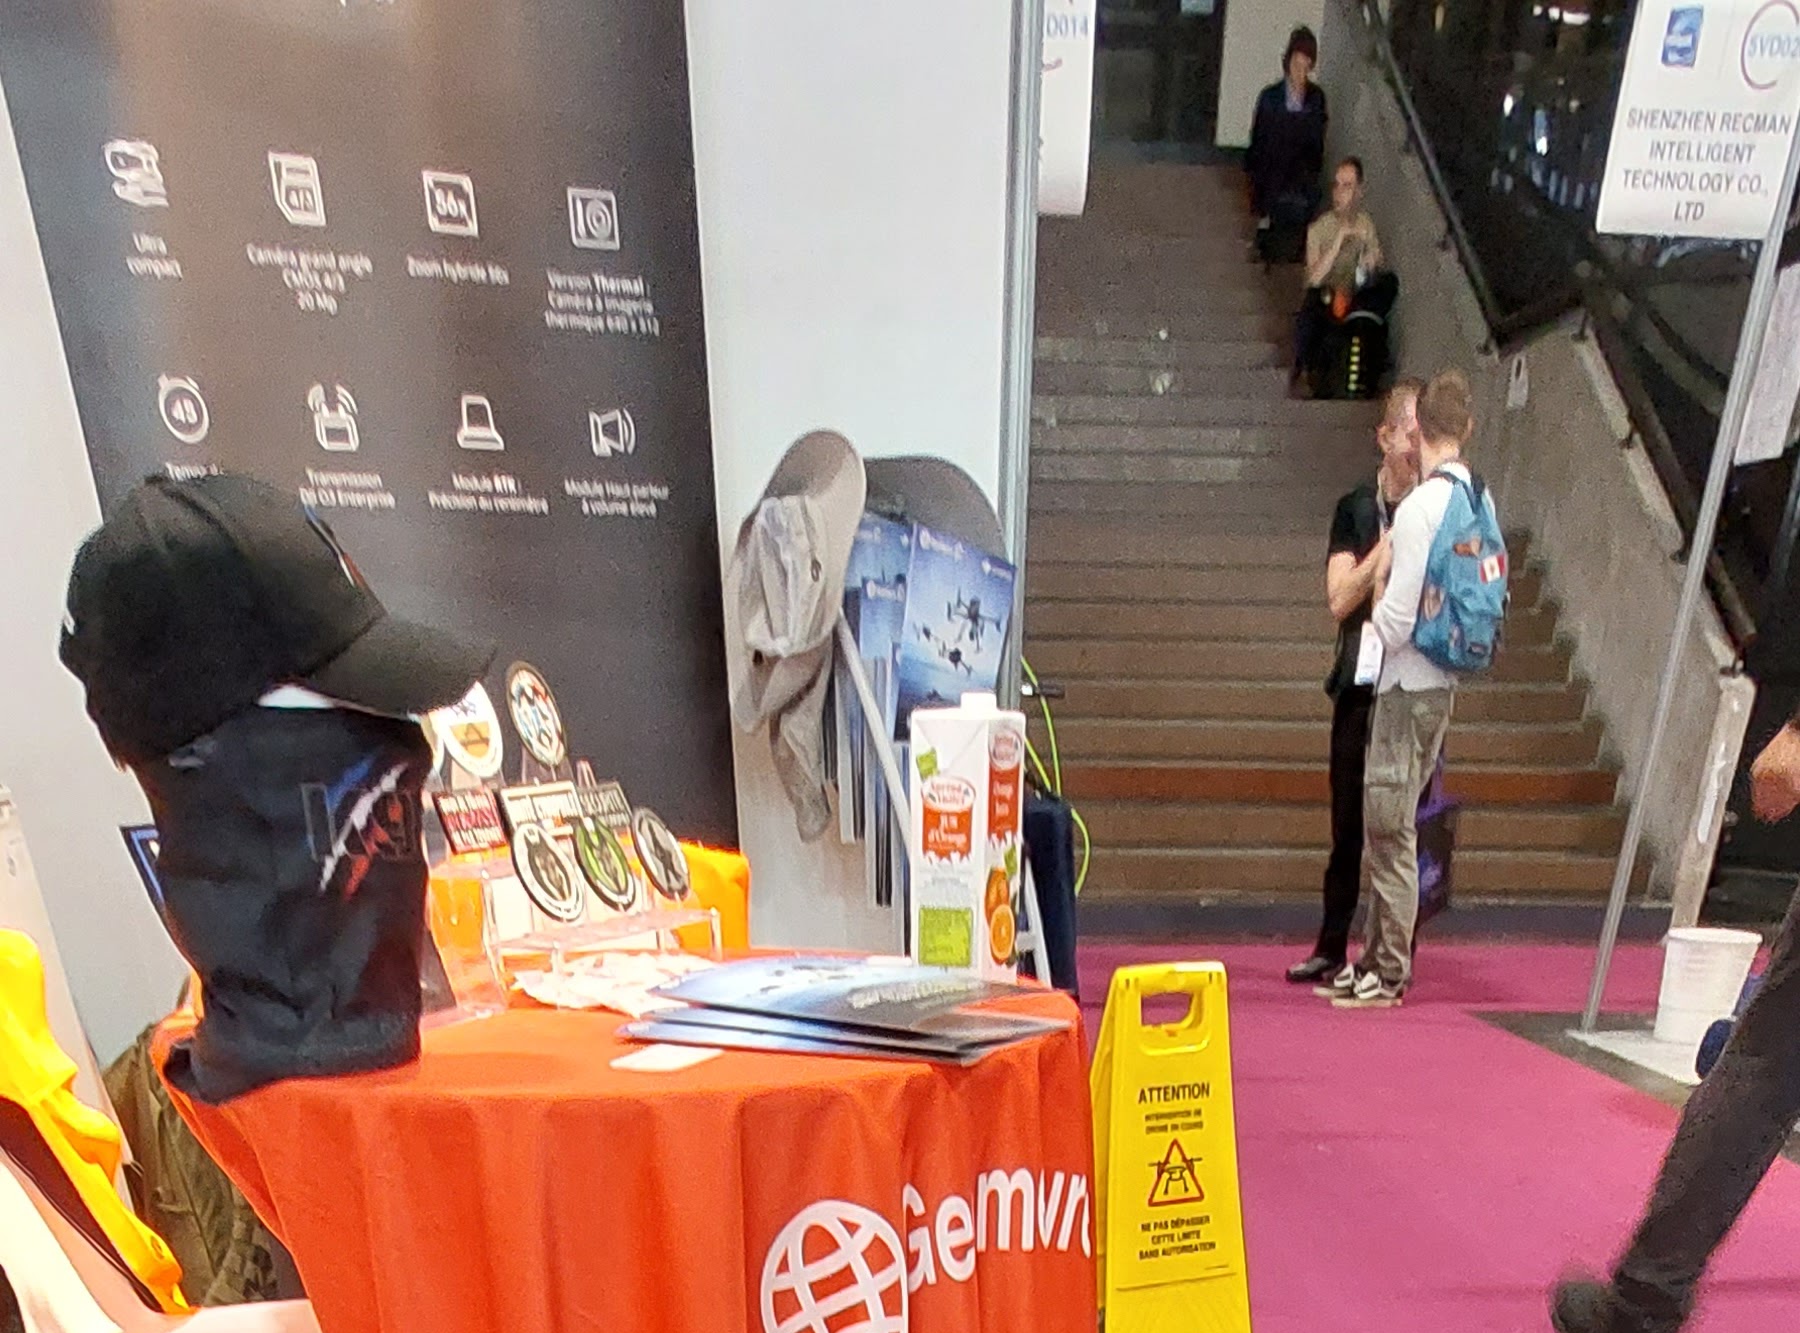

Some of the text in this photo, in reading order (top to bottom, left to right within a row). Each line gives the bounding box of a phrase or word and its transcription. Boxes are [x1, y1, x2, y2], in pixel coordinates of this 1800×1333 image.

[1626, 107, 1791, 136] SHENZHEN RECMAN
[1649, 140, 1756, 164] INTELLIGENT
[1623, 168, 1735, 193] TECHNOLOGY
[1674, 201, 1705, 223] LTD
[1138, 1082, 1211, 1104] ATTENTION
[1141, 1214, 1211, 1232] NE PAS DÉPASSER
[1151, 1230, 1202, 1246] CETTE LIMITE
[1139, 1240, 1217, 1261] SANS AUTORISATION
